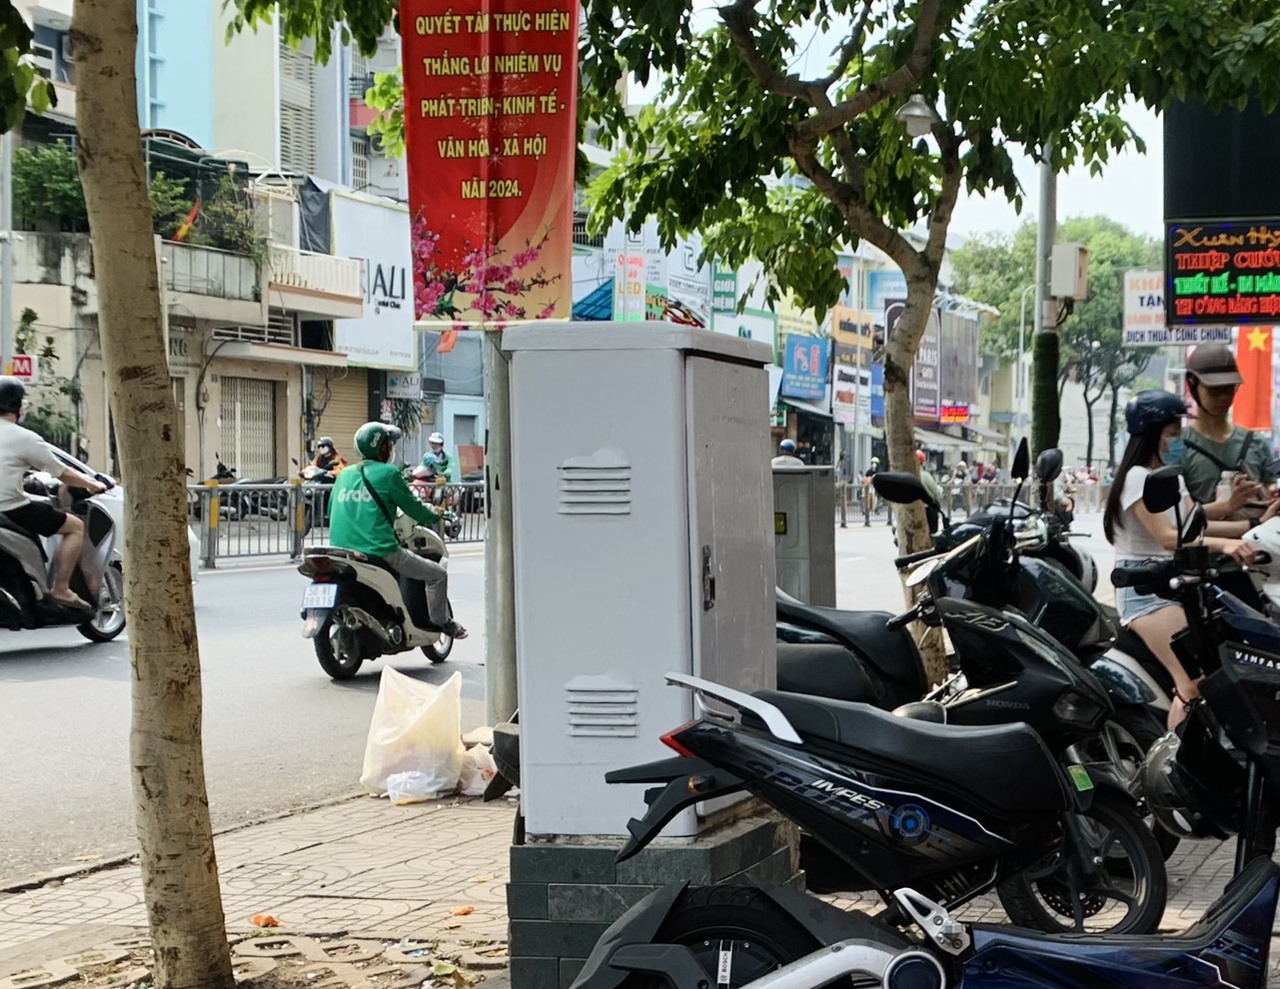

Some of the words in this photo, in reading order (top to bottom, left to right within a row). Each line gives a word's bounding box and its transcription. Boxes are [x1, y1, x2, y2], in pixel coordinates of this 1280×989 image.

[415, 8, 461, 35] QUYẾT
[494, 10, 531, 36] THỰC
[535, 8, 570, 36] HIỆN
[495, 50, 539, 78] NHIỆM
[543, 54, 562, 77] VỤ
[421, 94, 455, 117] PHÁT
[503, 96, 535, 115] KINH
[540, 88, 557, 114] TẾ
[438, 137, 464, 158] VĂN
[503, 133, 520, 156] XÃ
[523, 133, 547, 160] HỘI
[373, 263, 405, 299] ALI
[337, 487, 374, 503] Grab
[985, 699, 1032, 710] HONDA
[811, 779, 886, 810] IMPES
